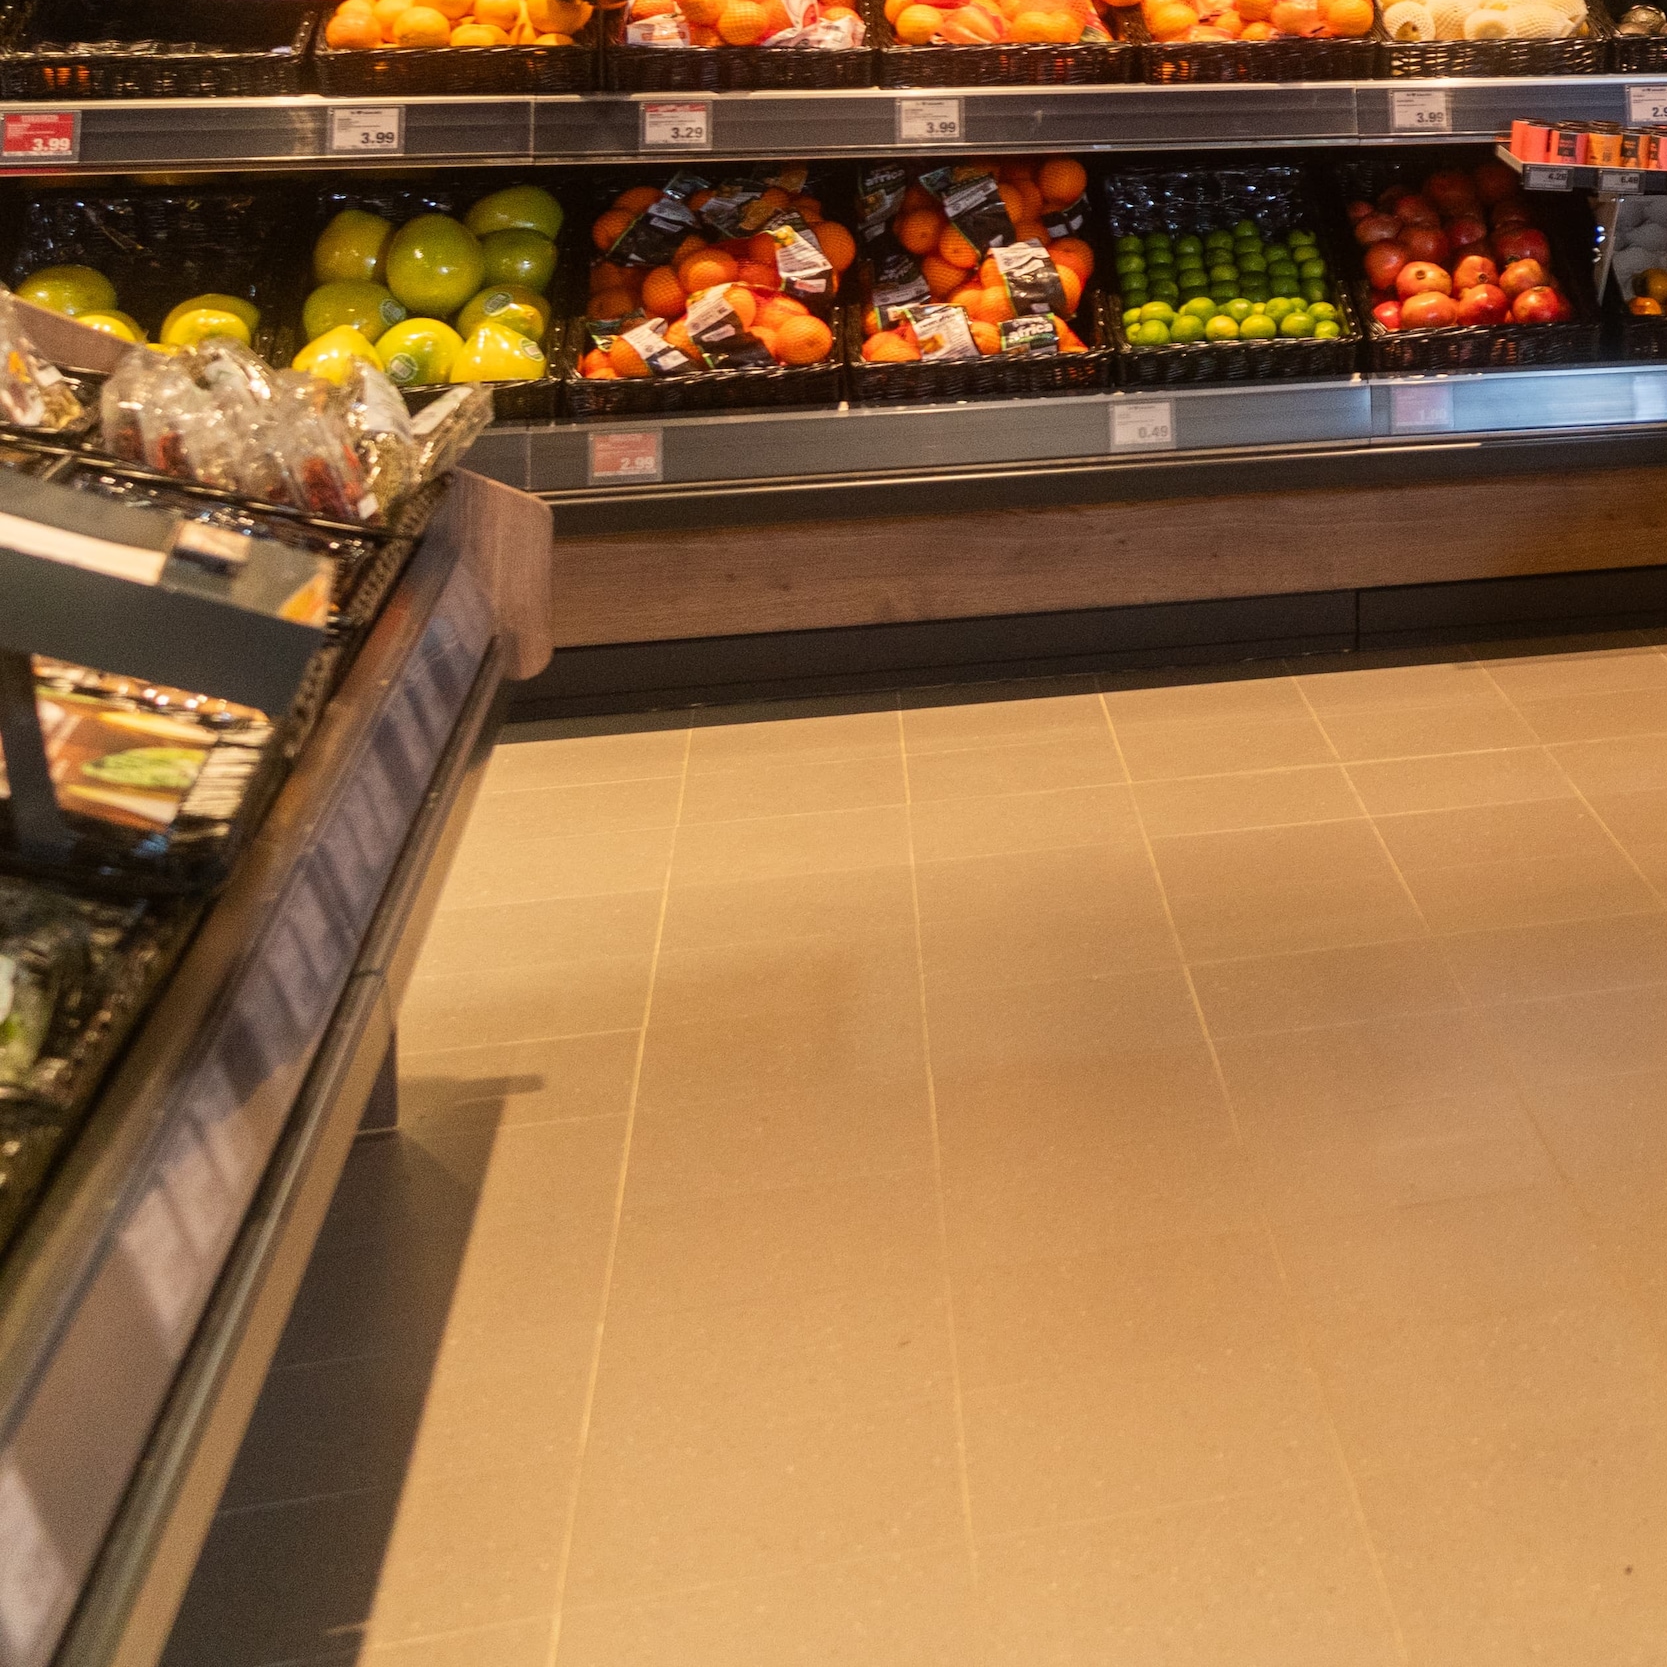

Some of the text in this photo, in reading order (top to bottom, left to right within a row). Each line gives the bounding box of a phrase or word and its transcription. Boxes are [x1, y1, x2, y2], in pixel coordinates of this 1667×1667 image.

[1416, 112, 1444, 123] 3.99
[671, 127, 703, 139] 3.29
[926, 121, 956, 133] 3.99
[361, 132, 395, 144] 3.99
[33, 138, 70, 151] 3.99
[1008, 322, 1054, 341] africa
